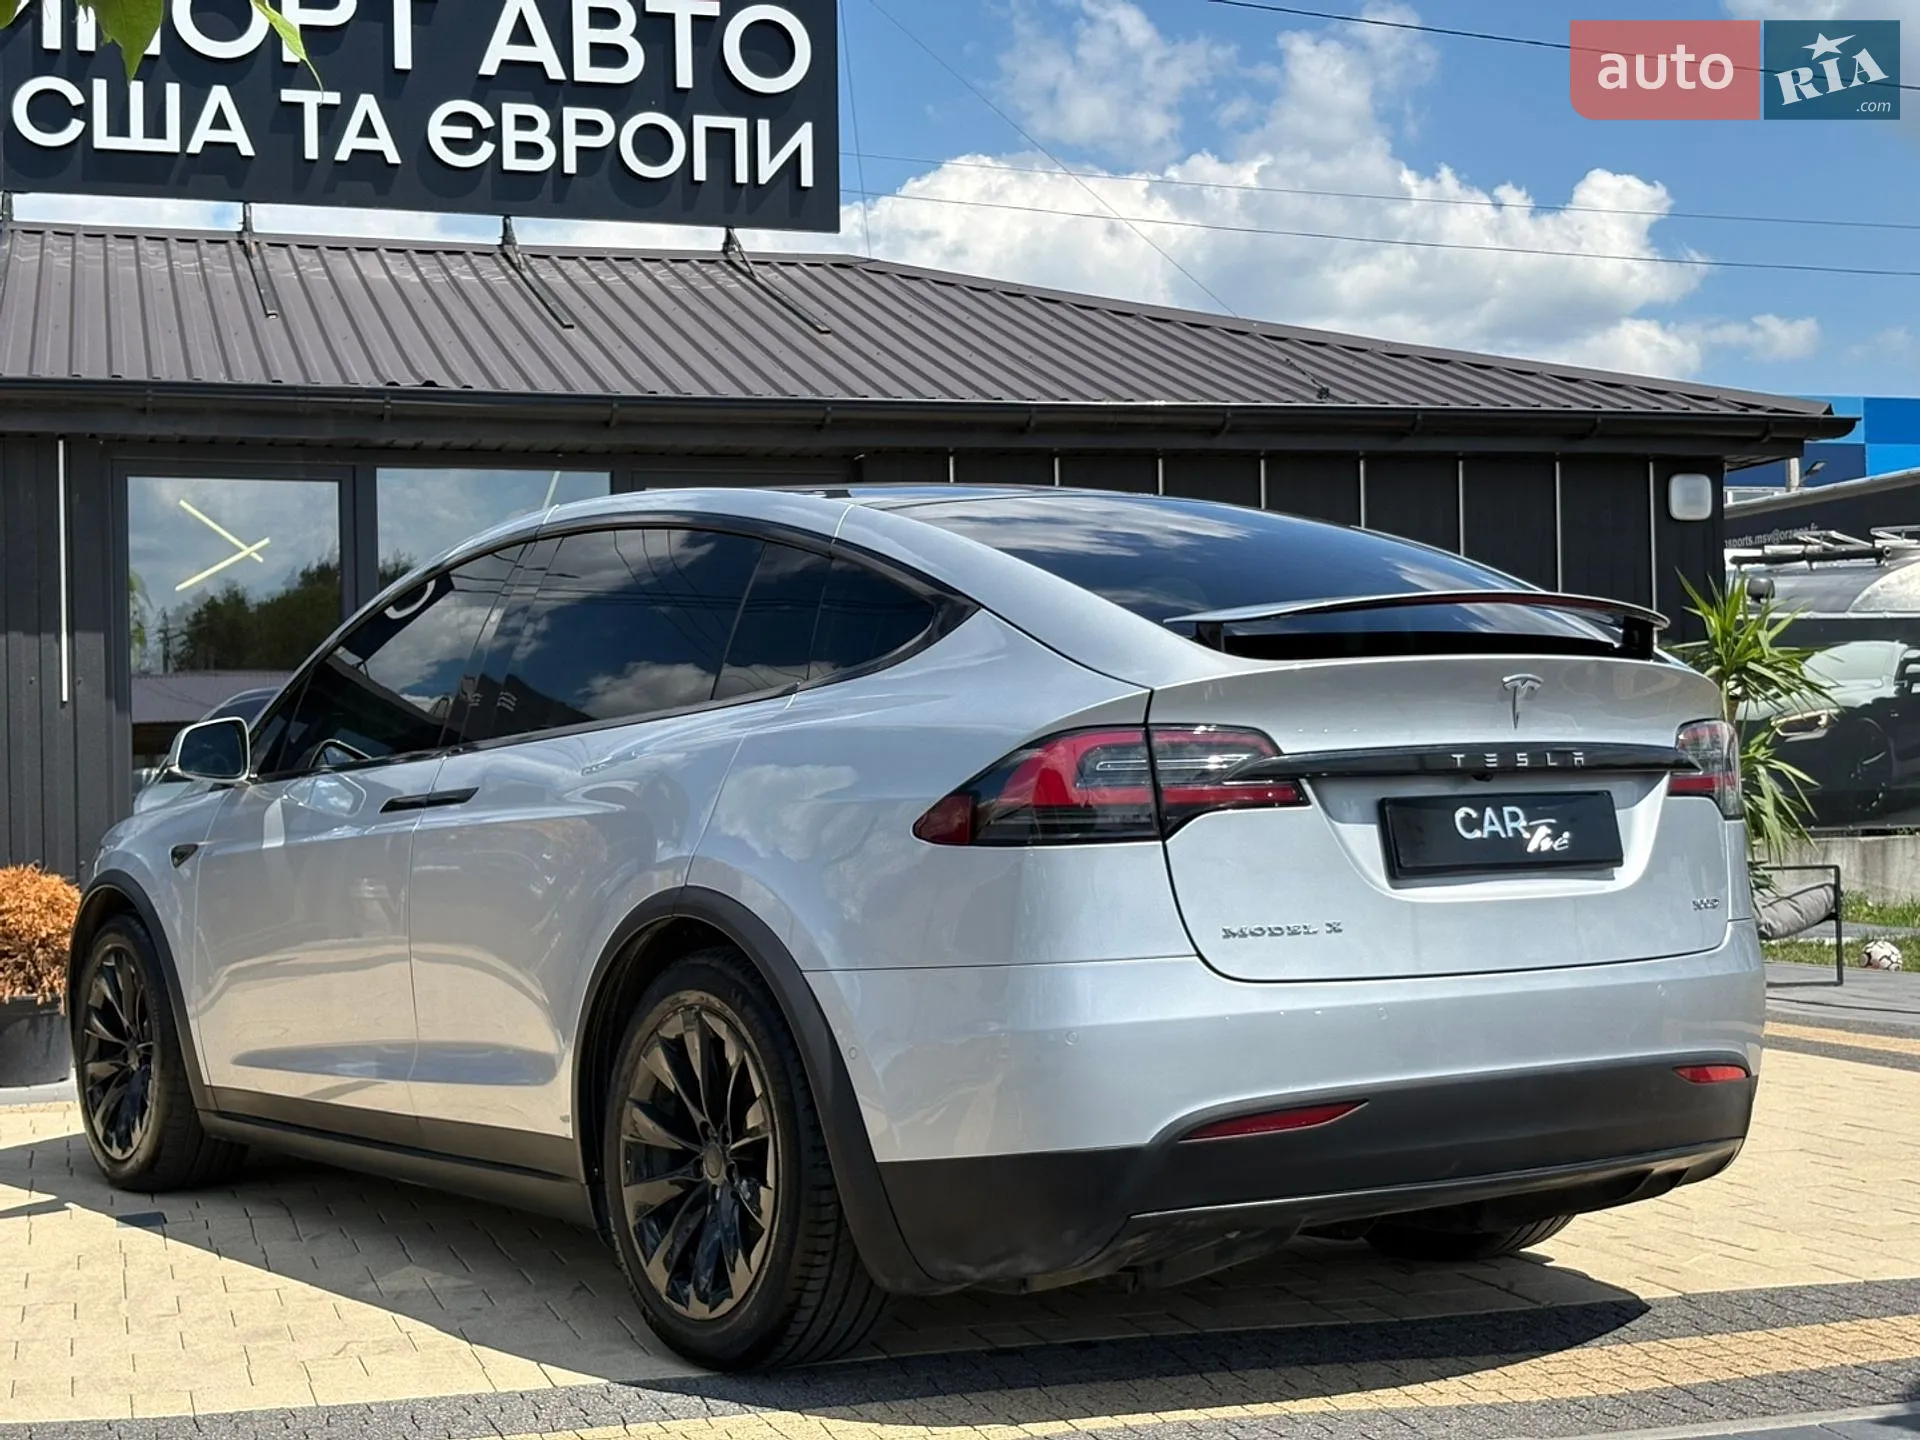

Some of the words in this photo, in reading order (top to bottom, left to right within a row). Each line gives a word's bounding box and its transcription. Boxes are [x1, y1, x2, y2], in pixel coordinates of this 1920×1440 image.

[478, 0, 812, 93] АВТО
[11, 75, 256, 157] США
[280, 88, 402, 165] ТА
[428, 99, 814, 189] ЄВРОПИ
[1451, 752, 1585, 768] TESLA
[1455, 806, 1531, 840] CAR
[1221, 925, 1319, 939] MODEL
[1325, 921, 1344, 934] X
